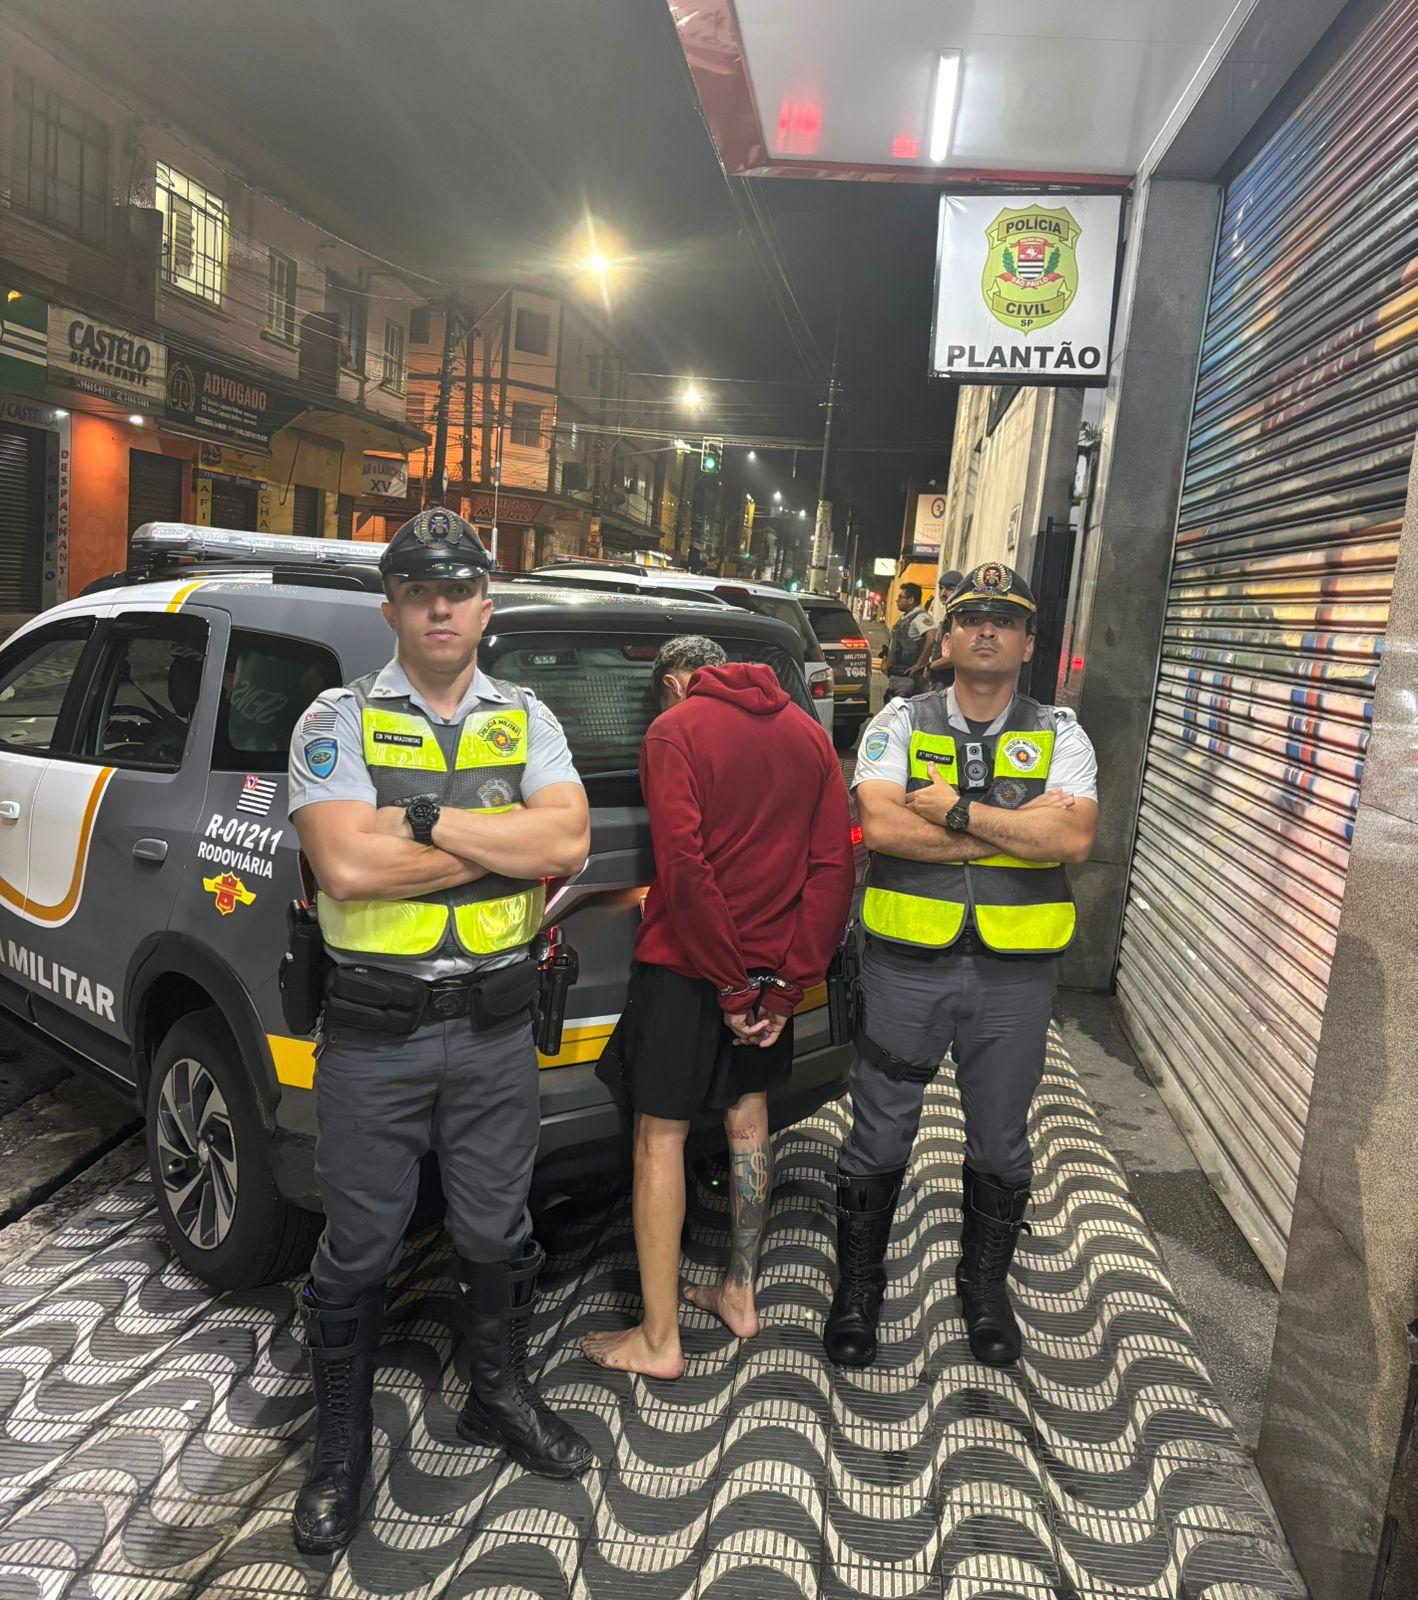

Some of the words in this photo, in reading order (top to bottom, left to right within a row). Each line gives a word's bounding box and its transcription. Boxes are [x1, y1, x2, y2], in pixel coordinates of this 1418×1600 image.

[1005, 216, 1062, 235] POLÍCIA
[1005, 302, 1051, 316] CIVIL
[1020, 319, 1034, 327] SP
[68, 320, 152, 373] CASTELO
[947, 341, 1102, 370] PLANTÃO
[69, 350, 149, 388] DESPACHANTE
[203, 372, 269, 412] ADVOGADO
[371, 479, 393, 493] XV
[844, 666, 867, 678] TOR
[204, 813, 284, 856] R-01211
[197, 841, 273, 879] RODOVIÁRIA
[8, 939, 116, 1023] MILITAR
